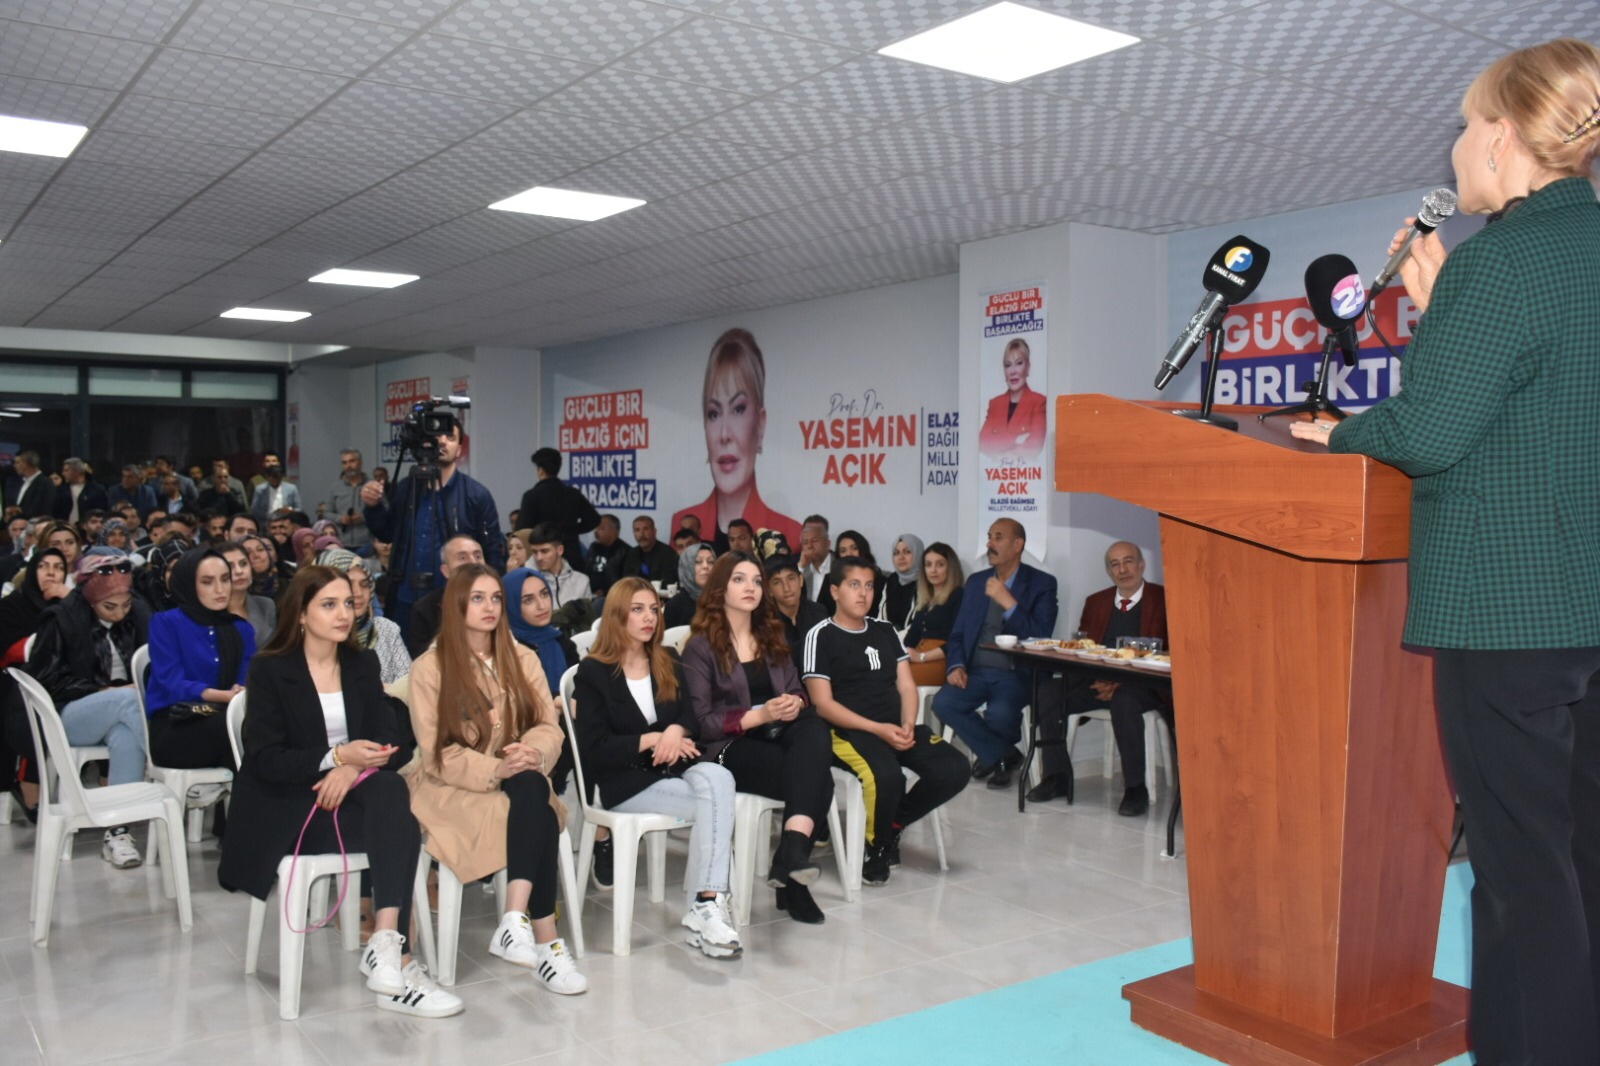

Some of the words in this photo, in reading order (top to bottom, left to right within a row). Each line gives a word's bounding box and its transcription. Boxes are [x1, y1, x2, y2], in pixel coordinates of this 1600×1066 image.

[1211, 263, 1228, 278] KANAL
[1333, 274, 1365, 317] 23
[1222, 300, 1375, 353] GÜÇ
[565, 395, 612, 421] GÜÇLÜ
[616, 392, 641, 417] BİR
[827, 393, 858, 420] Prof.
[863, 389, 884, 417] Dr.
[561, 422, 610, 450] ELAZIĞ
[615, 423, 646, 449] İÇİN
[799, 414, 916, 450] YASEMİN
[572, 454, 633, 478] BİRLİKTE
[822, 453, 886, 487] AÇIK
[985, 467, 1042, 480] YASEMİN
[573, 481, 654, 507] RACAĞIZ
[997, 482, 1029, 496] AÇIK
